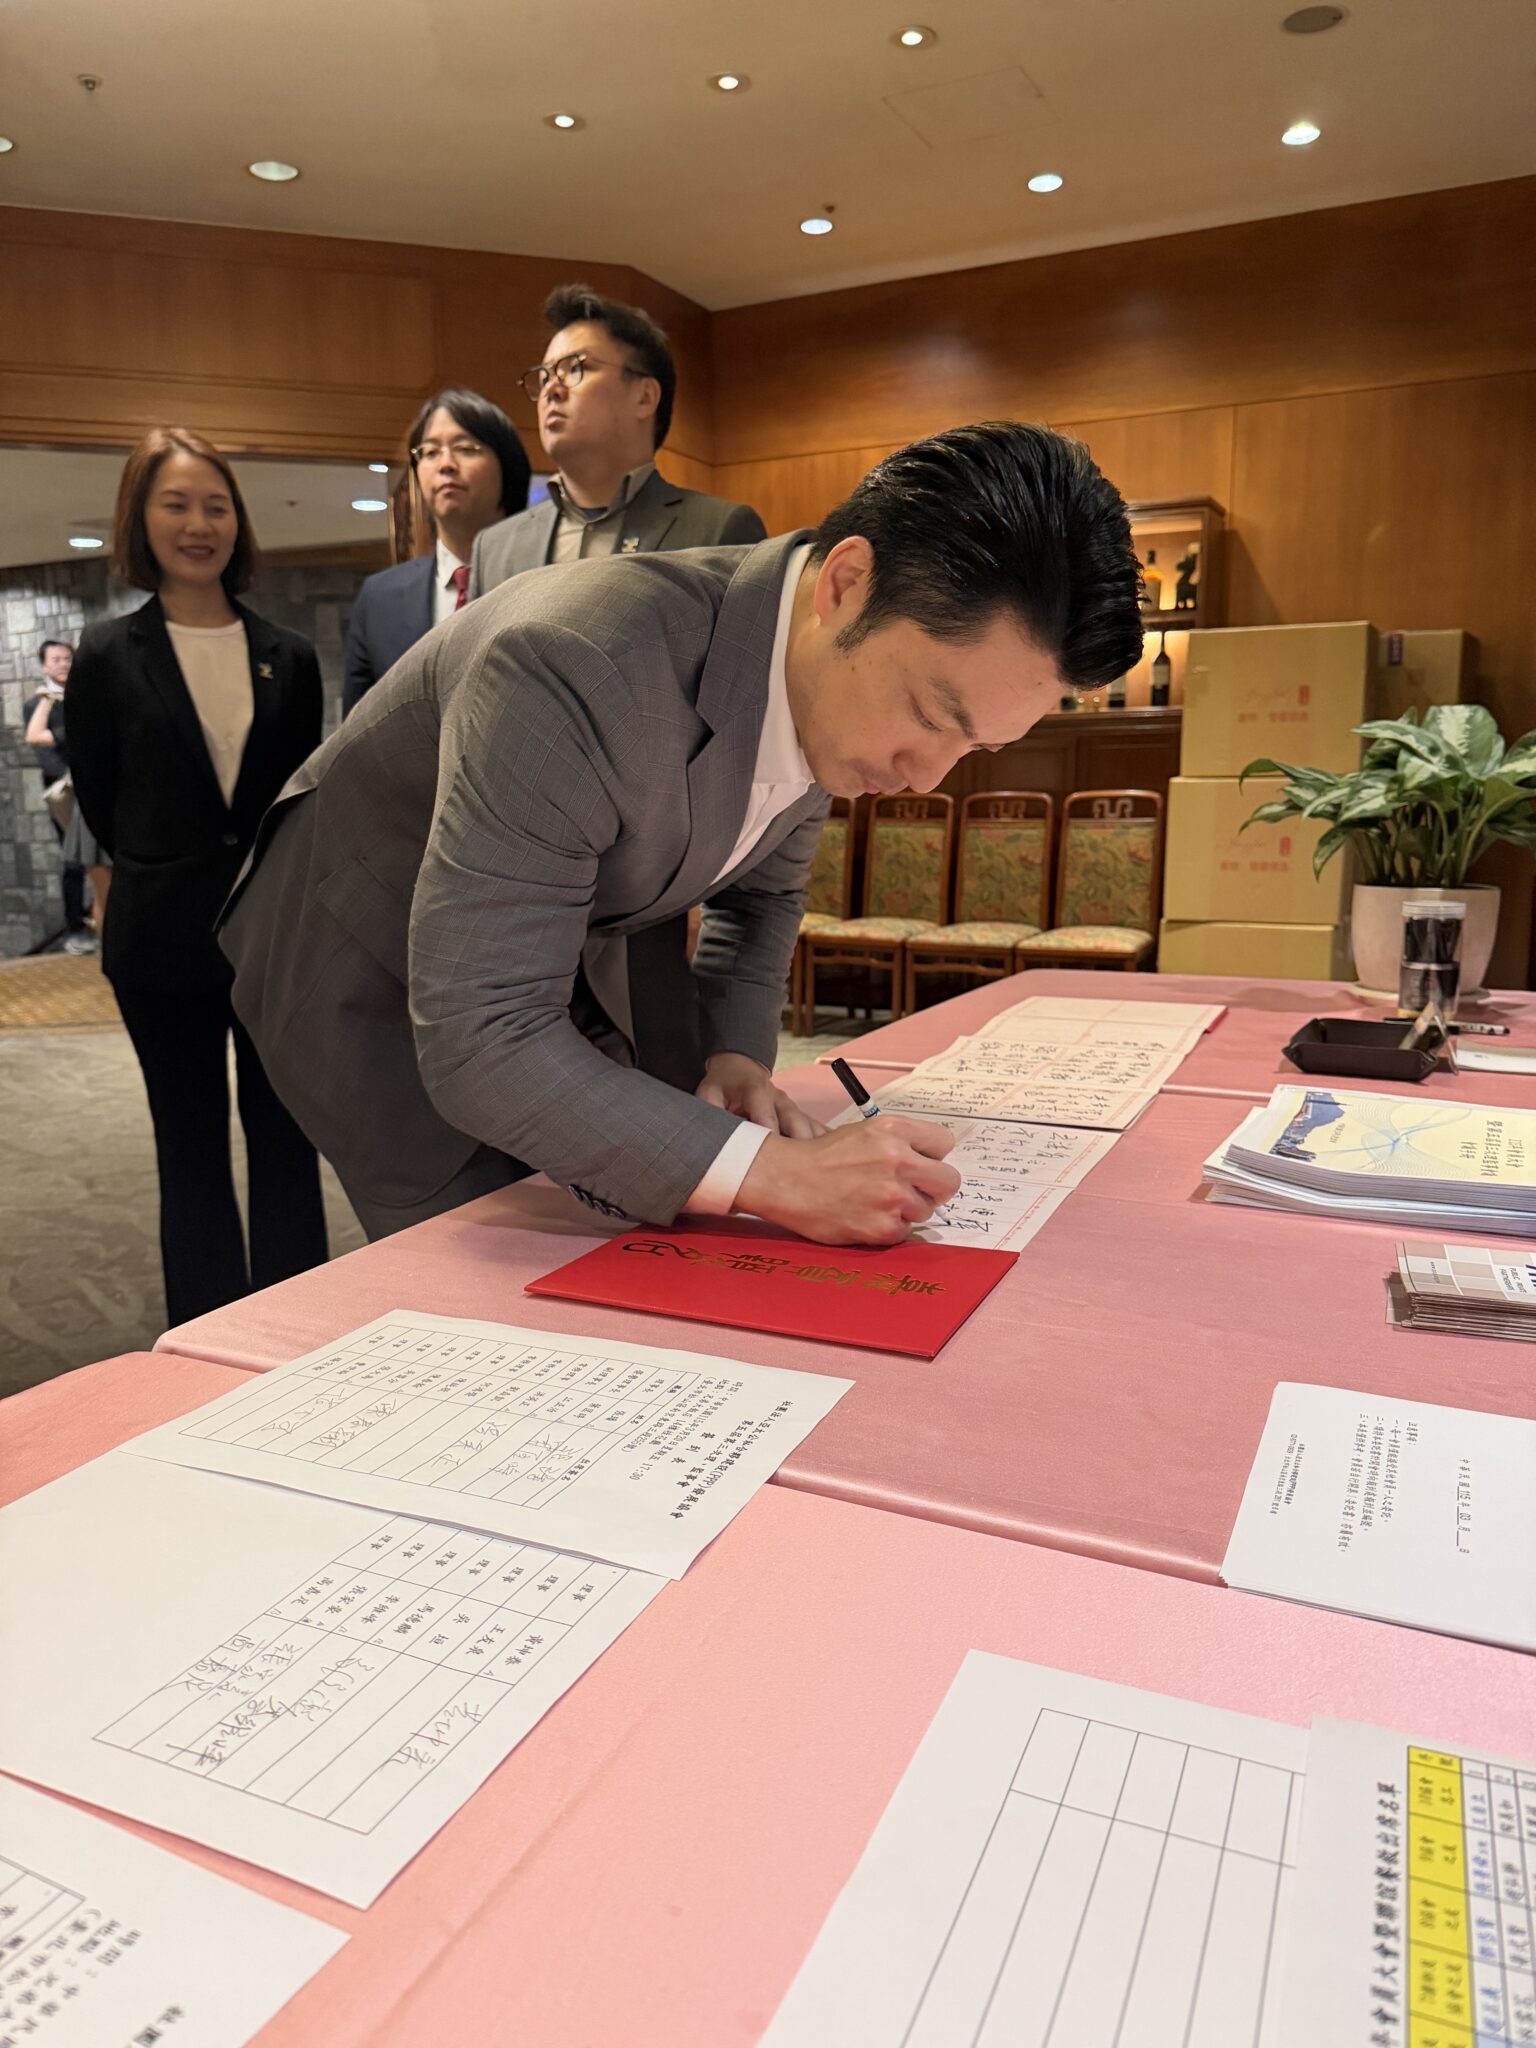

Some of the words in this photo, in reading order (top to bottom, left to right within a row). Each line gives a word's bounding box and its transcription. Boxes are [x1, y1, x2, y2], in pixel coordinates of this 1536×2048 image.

[370, 1535, 393, 1550] 理事
[402, 1543, 424, 1558] 理事
[435, 1551, 457, 1567] 理事
[468, 1559, 490, 1576] 理事
[502, 1567, 524, 1583] 理事
[537, 1575, 559, 1592] 理事
[325, 1581, 368, 1614] 張家豪
[572, 1584, 595, 1602] 理事
[465, 1624, 506, 1655] 王友泉
[505, 1635, 544, 1665] 黃坤泰
